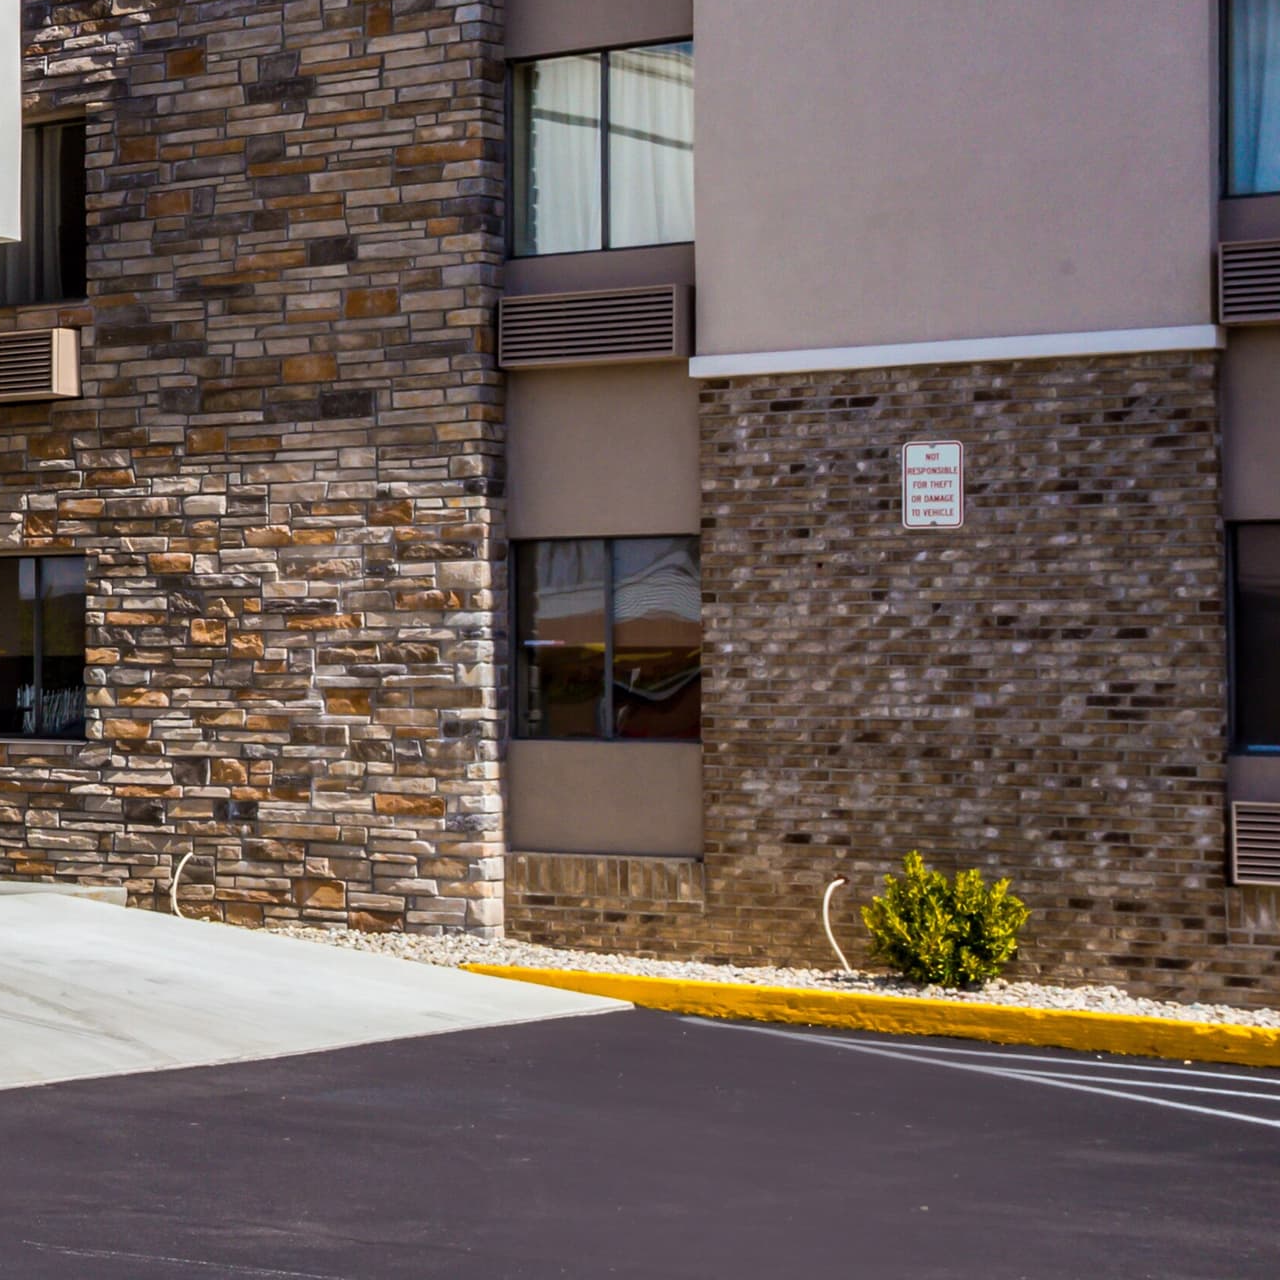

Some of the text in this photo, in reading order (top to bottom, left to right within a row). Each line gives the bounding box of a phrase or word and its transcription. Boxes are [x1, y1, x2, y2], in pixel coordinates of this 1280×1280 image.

[925, 452, 940, 461] NOT
[907, 466, 958, 475] RESPONSIBLE
[913, 480, 953, 489] FOR THEFT
[911, 494, 955, 503] OR DAMAGE
[912, 508, 955, 517] TO VEHICLE
